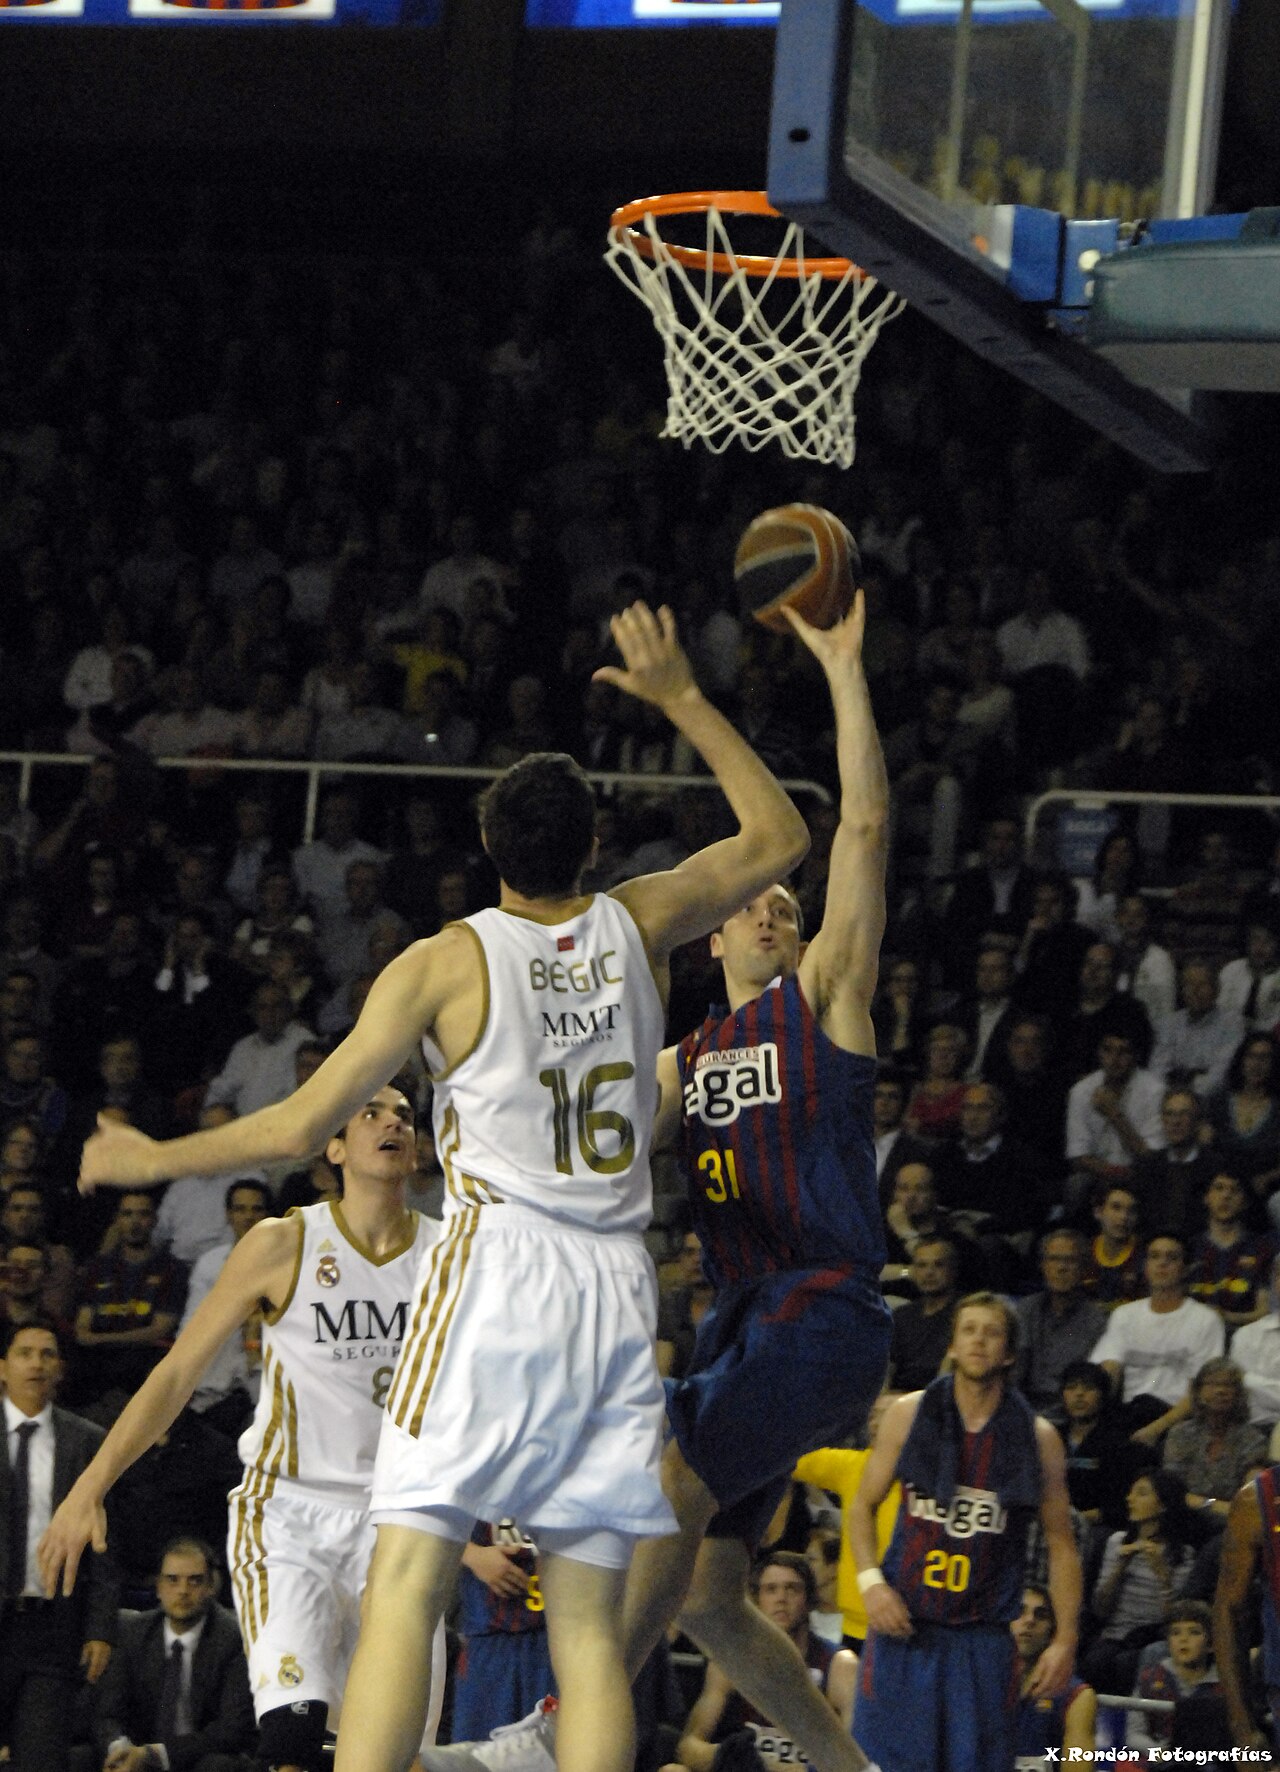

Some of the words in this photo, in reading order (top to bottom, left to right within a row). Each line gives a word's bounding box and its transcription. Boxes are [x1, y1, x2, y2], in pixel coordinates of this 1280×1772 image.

[529, 950, 623, 993] BEGIC
[541, 1003, 621, 1037] MMT
[553, 1033, 613, 1048] SEGUROS
[538, 1061, 635, 1176] 16
[698, 1149, 740, 1203] 31
[310, 1300, 411, 1344] MM
[332, 1345, 402, 1361] SEGUR
[923, 1549, 971, 1592] 20
